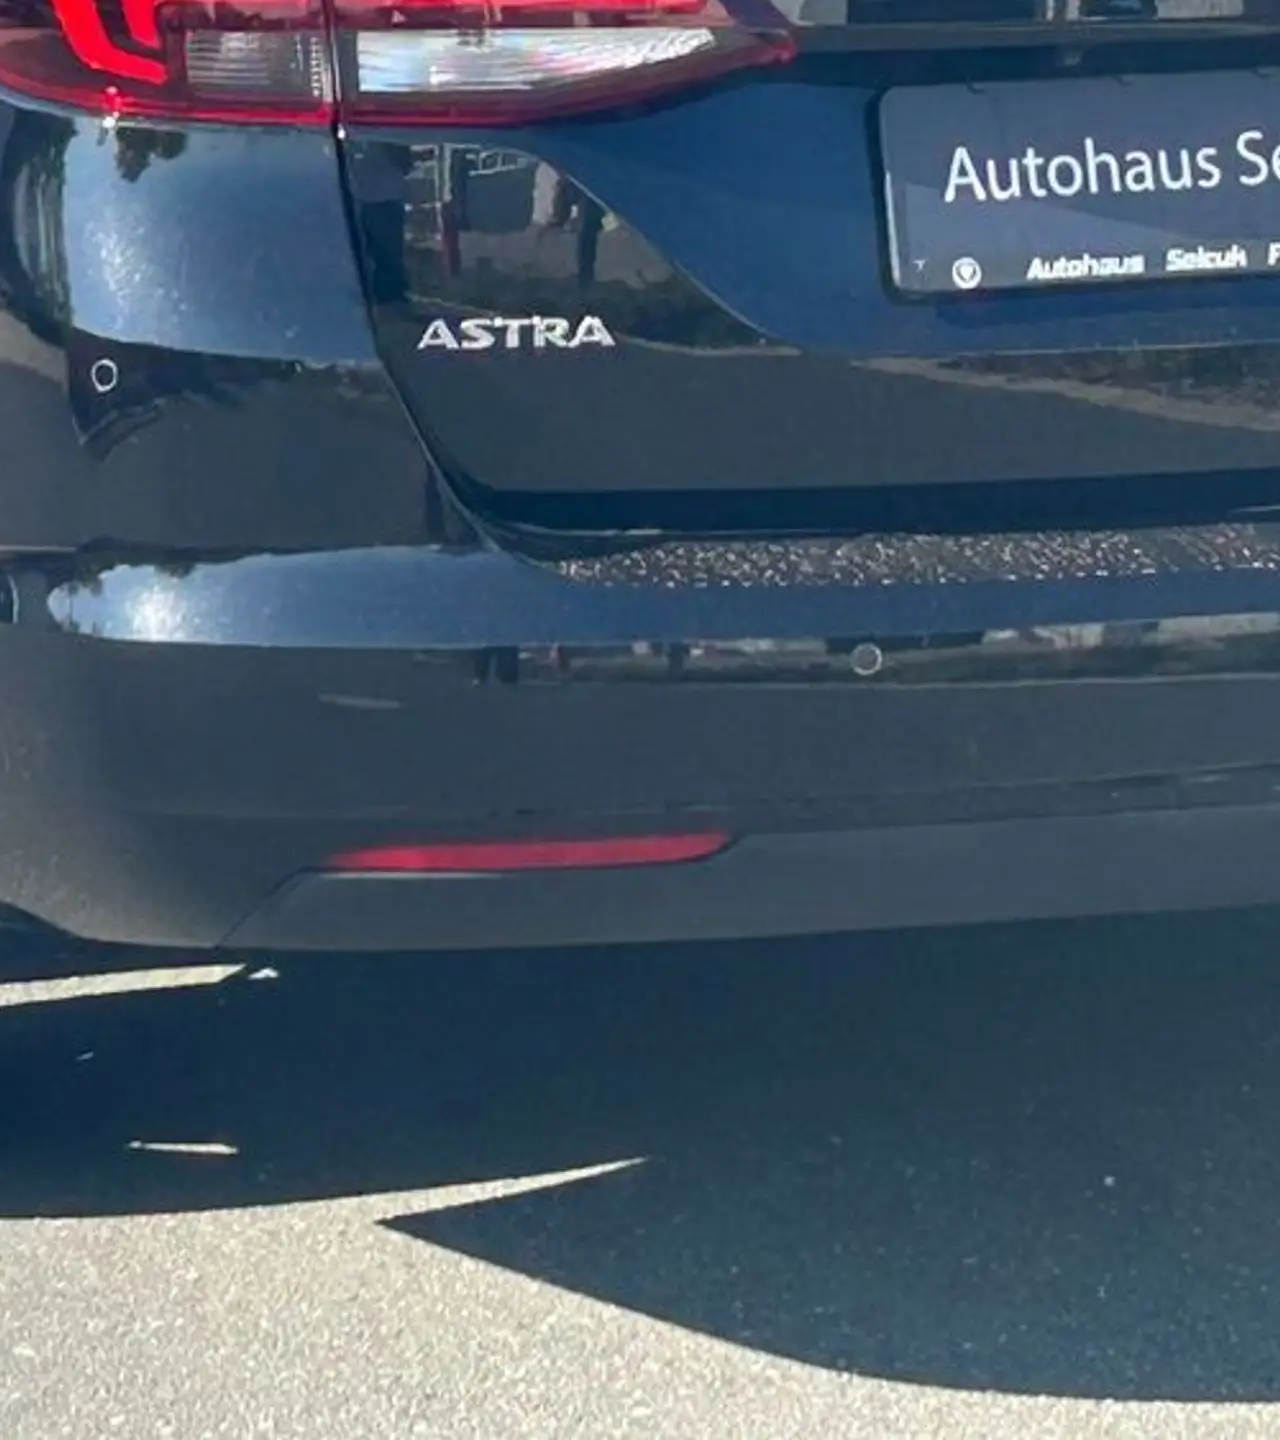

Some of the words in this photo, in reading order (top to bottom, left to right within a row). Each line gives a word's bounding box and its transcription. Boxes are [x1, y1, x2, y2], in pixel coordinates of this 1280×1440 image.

[944, 137, 1221, 203] Autohaus
[1026, 254, 1146, 281] Autohaus
[1165, 244, 1248, 272] Selcuk
[417, 315, 616, 351] ASTRA
